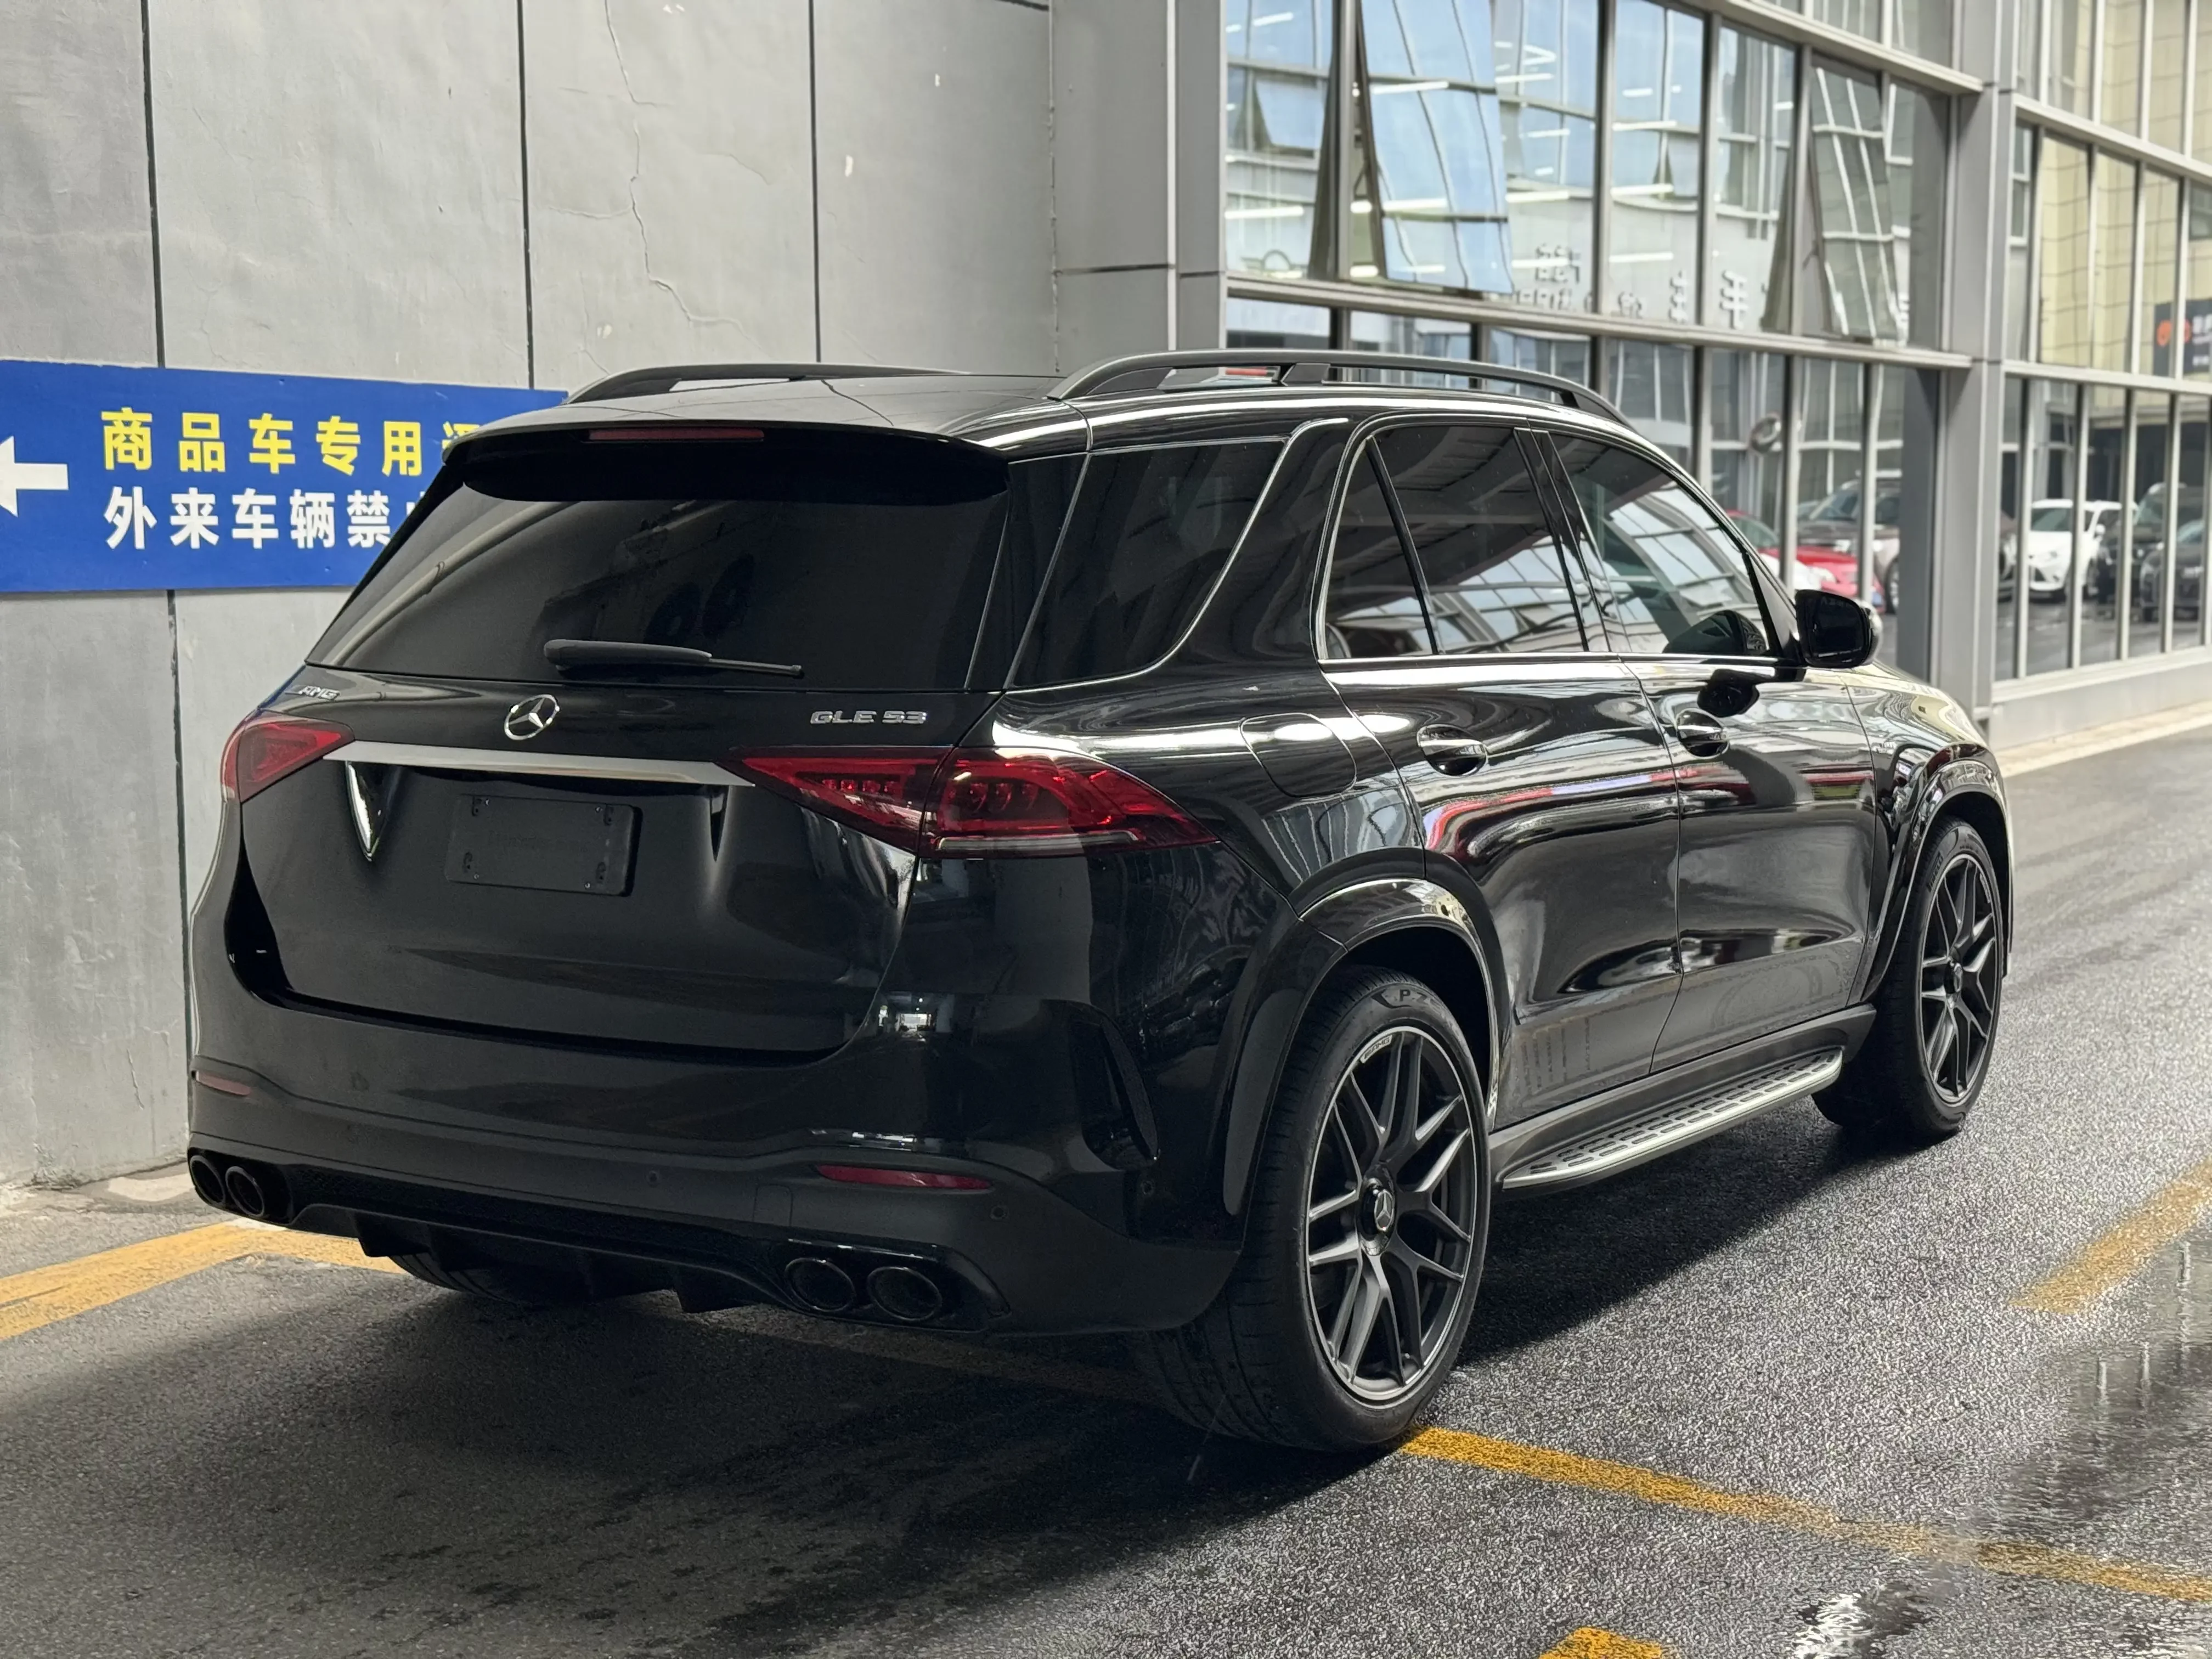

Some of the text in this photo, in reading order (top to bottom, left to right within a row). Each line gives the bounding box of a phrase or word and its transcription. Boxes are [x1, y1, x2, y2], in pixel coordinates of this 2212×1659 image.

[101, 407, 479, 476] 商品车专用
[104, 486, 425, 549] 外来车辆禁
[810, 710, 927, 724] GLE 53
